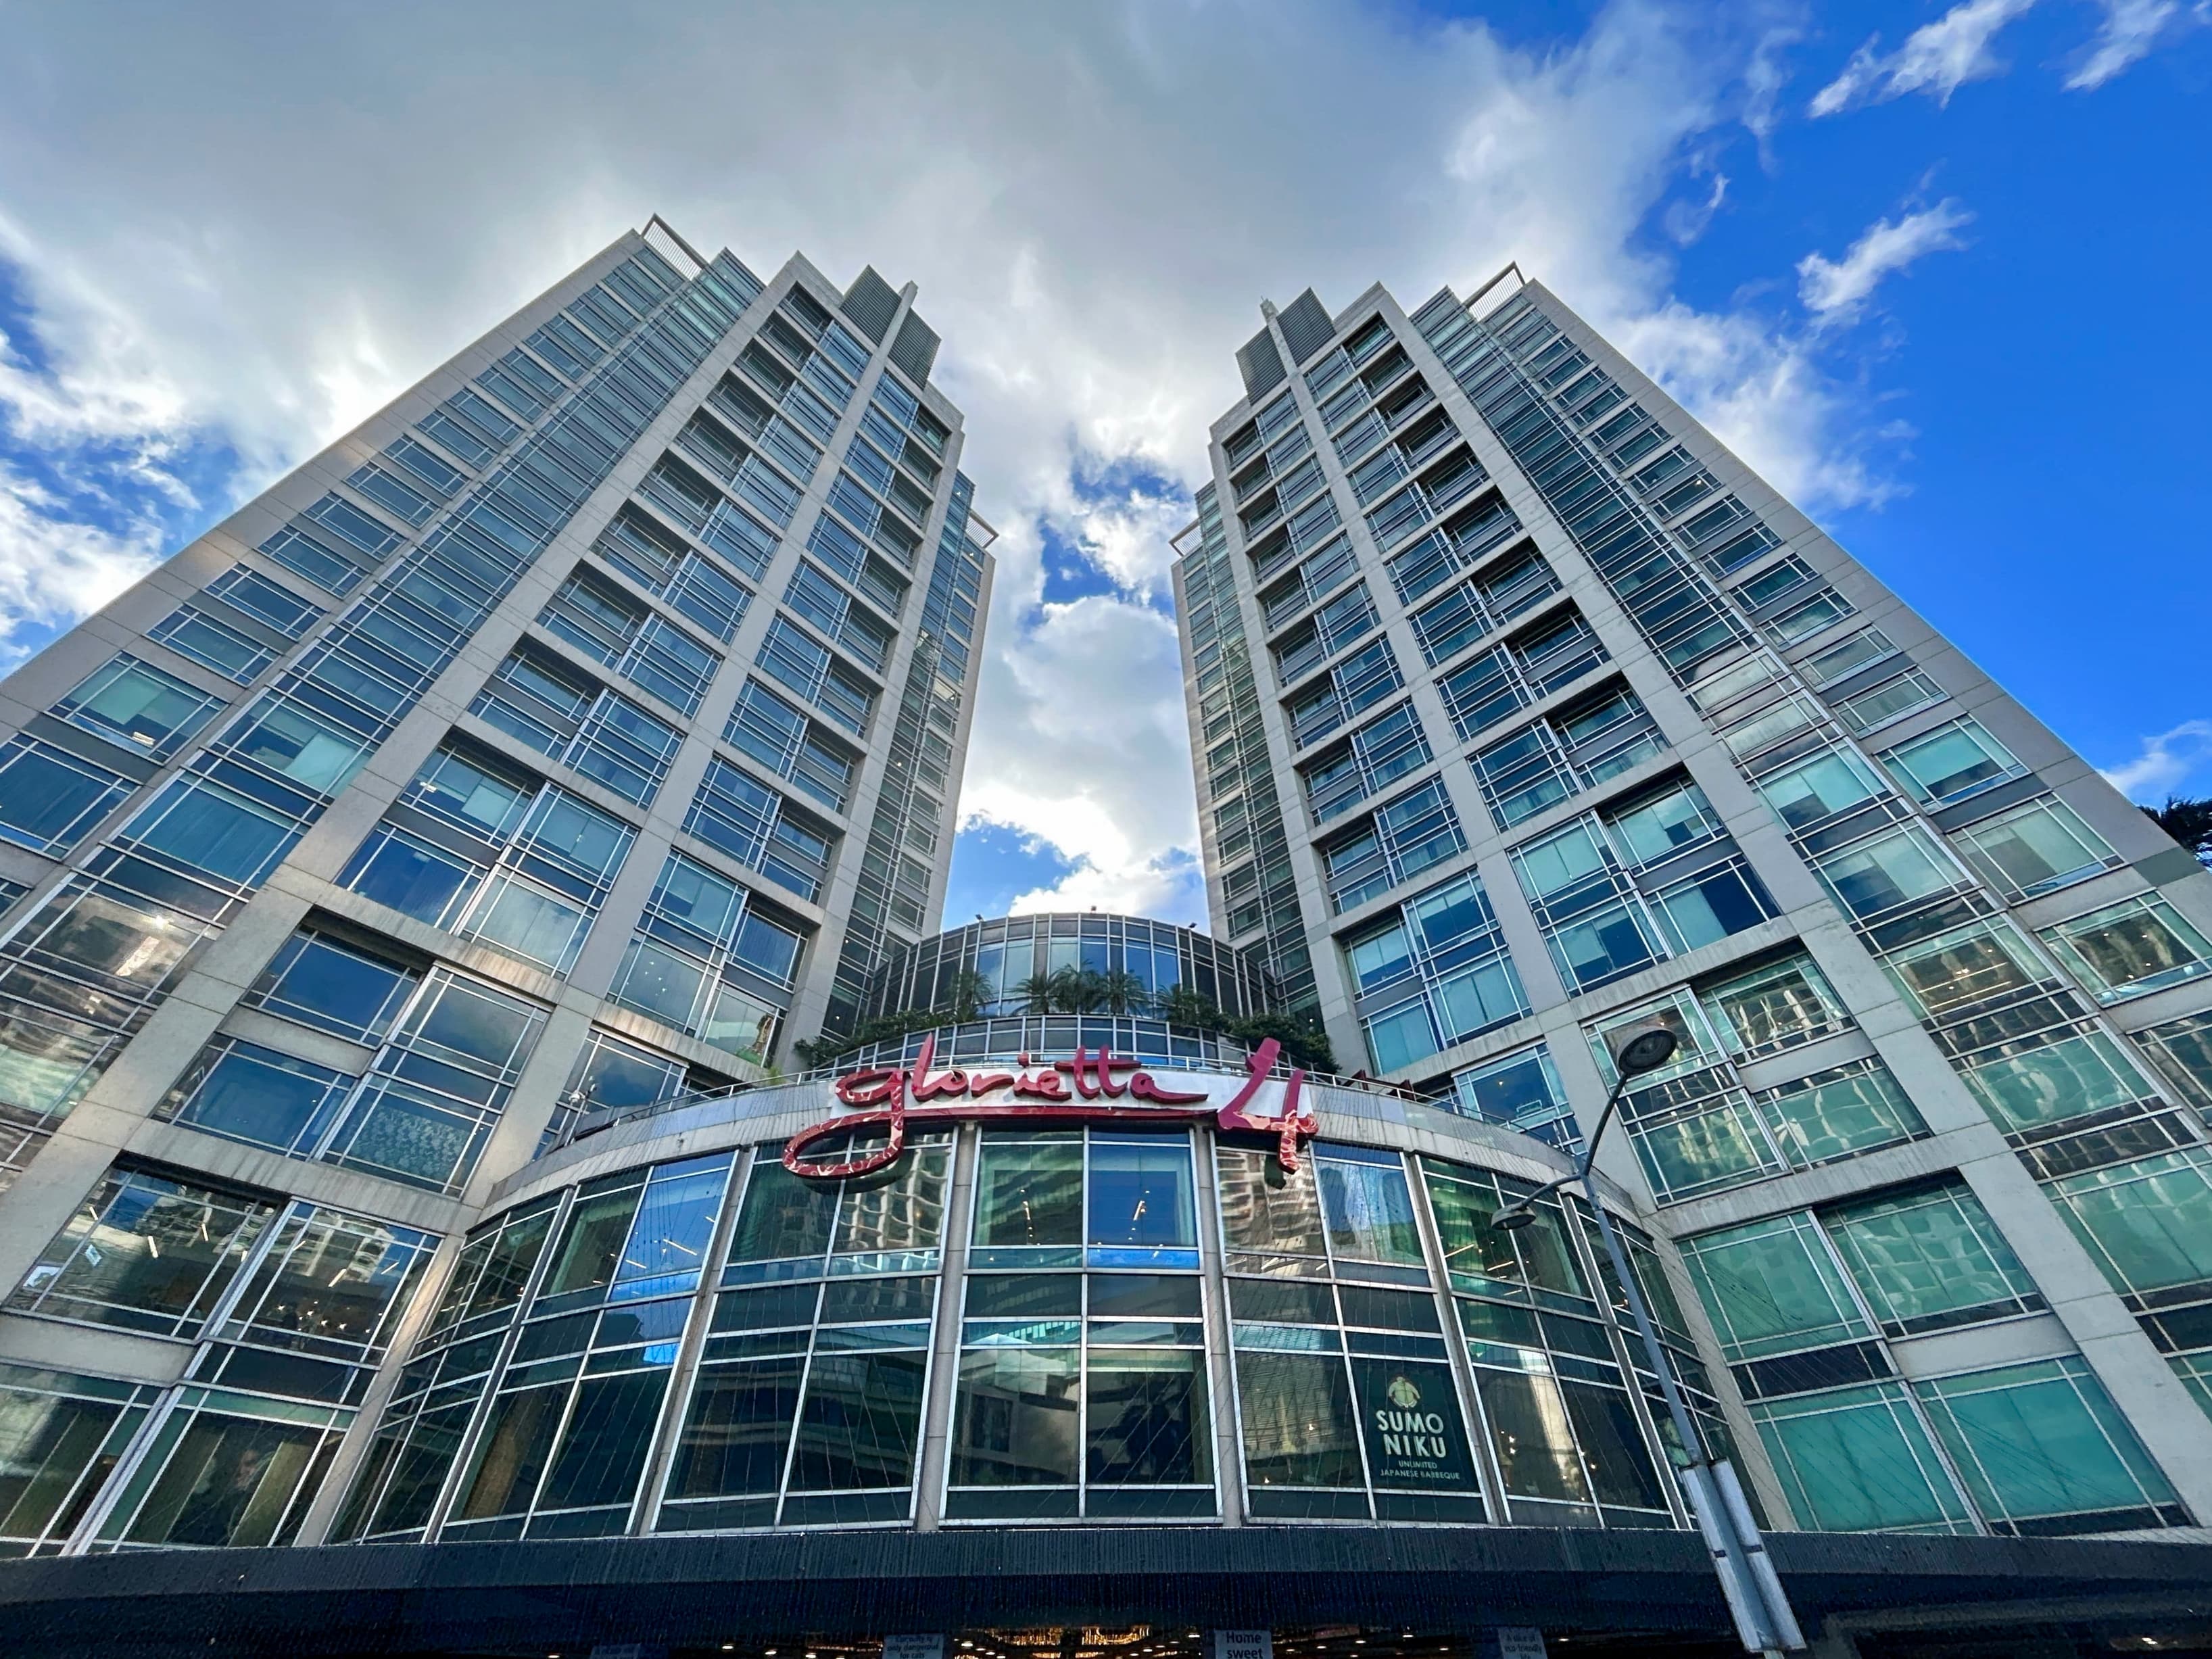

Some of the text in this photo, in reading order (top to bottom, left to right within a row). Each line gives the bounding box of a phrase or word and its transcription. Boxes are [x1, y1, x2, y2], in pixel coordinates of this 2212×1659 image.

[782, 1032, 1320, 1179] glorietta 4
[1376, 1410, 1444, 1434] SUMO
[1384, 1434, 1447, 1458] NIKU
[1398, 1460, 1437, 1469] UNLIMITED
[1380, 1469, 1419, 1478] JAPANESE
[1226, 1631, 1262, 1643] Home
[1227, 1648, 1264, 1659] sweet
